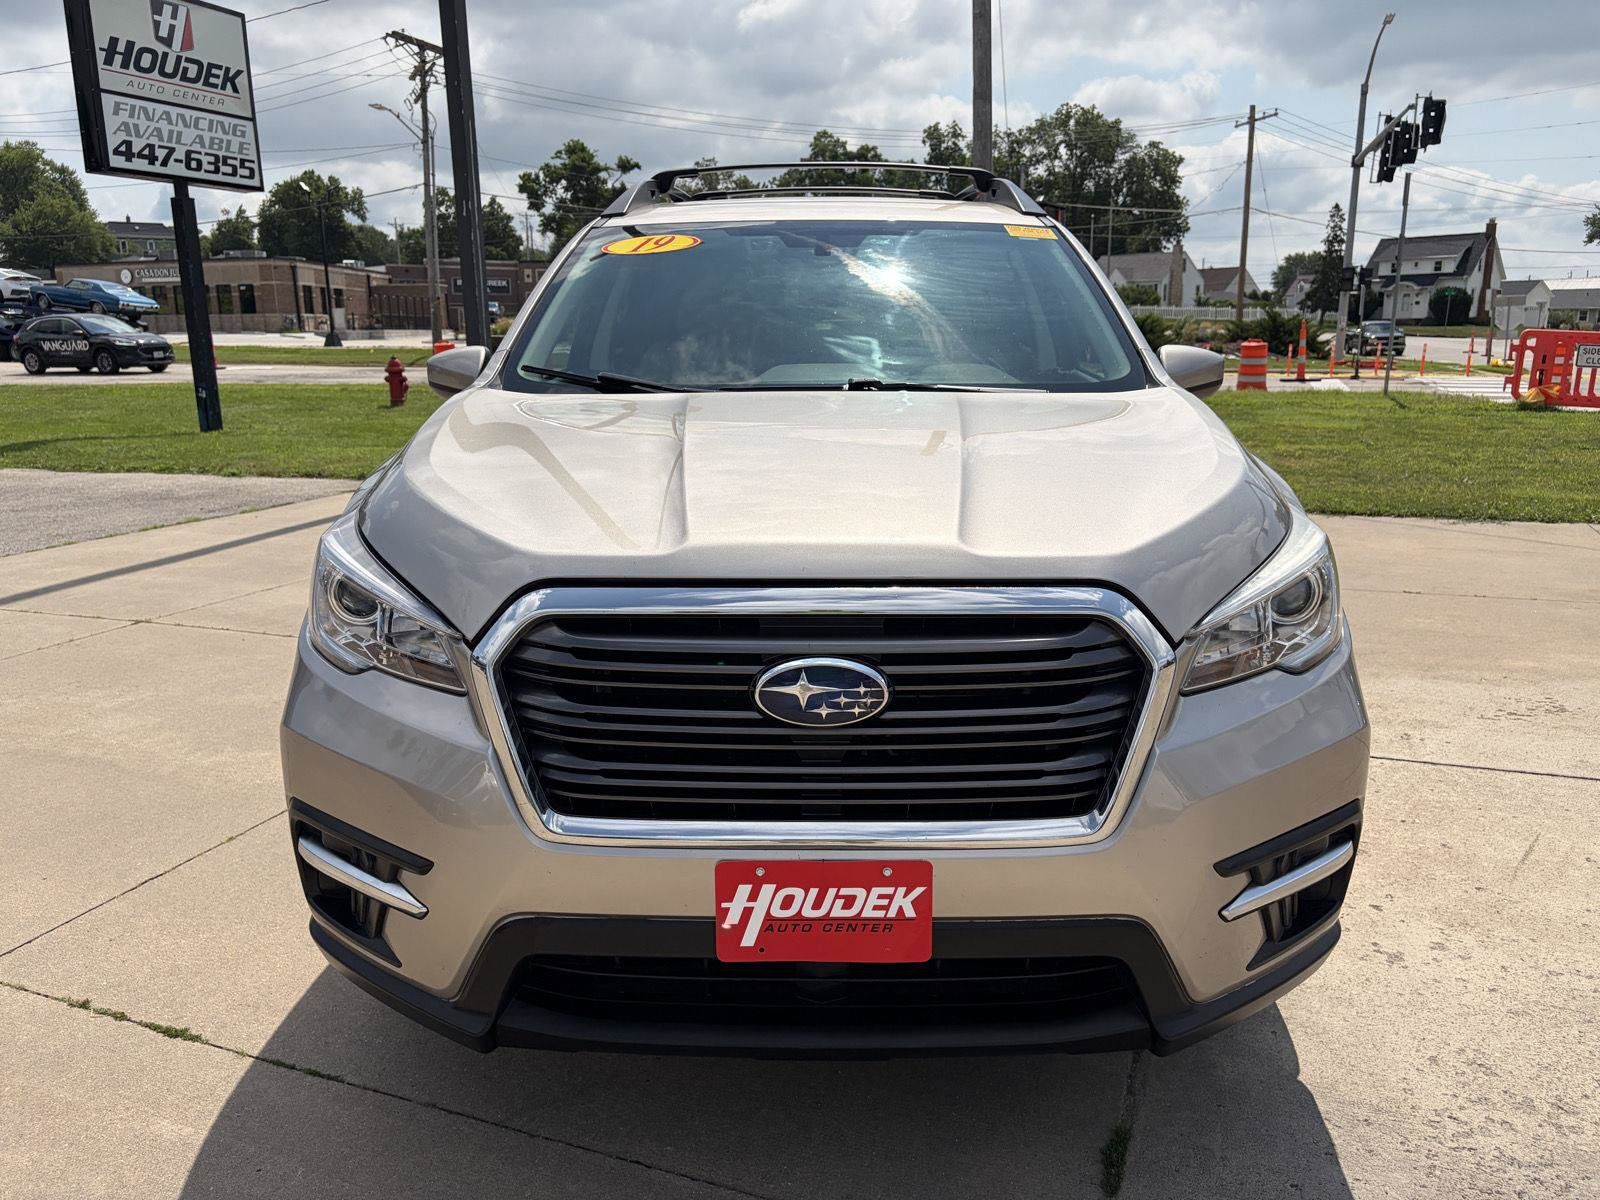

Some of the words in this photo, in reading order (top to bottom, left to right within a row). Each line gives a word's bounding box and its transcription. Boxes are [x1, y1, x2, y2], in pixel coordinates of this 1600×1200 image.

[99, 36, 244, 94] HOUDEK
[126, 79, 164, 94] AUTO
[173, 89, 225, 107] CENTER
[112, 100, 247, 138] FINANCING
[112, 120, 251, 156] AVAILABLE
[112, 139, 256, 180] 447-6355
[631, 235, 676, 252] 19
[40, 340, 90, 351] VANGUARD
[720, 884, 928, 947] HOUDEK
[764, 923, 813, 933] AUTO
[822, 923, 894, 933] CENTER
